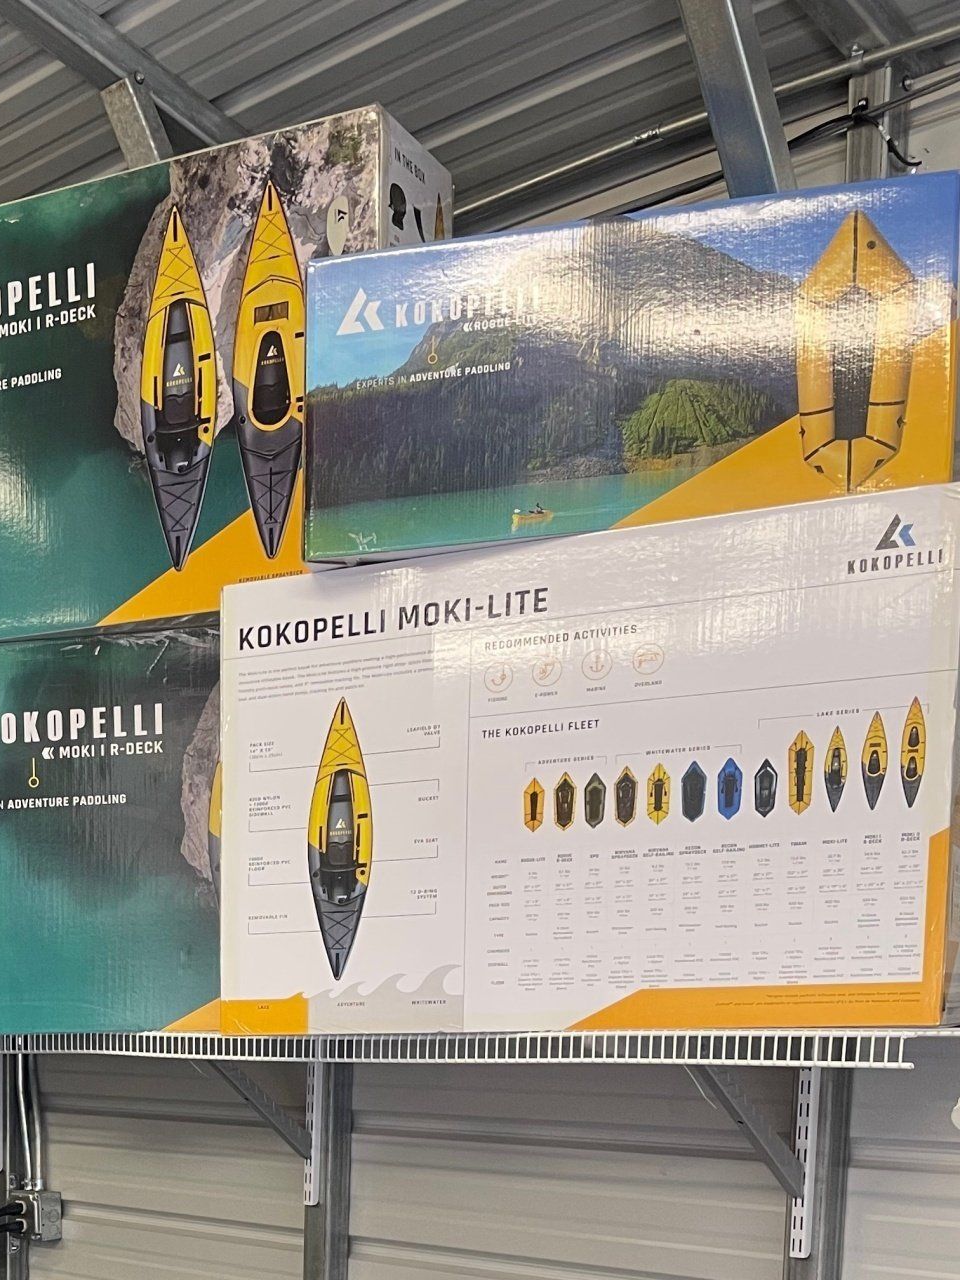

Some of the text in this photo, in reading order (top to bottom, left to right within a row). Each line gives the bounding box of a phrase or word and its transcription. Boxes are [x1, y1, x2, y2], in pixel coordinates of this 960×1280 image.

[45, 304, 96, 328] R-DECK
[11, 367, 62, 389] PADDLING
[356, 361, 511, 389] EXPERTS IN ADVENTURE PADDLING
[847, 548, 943, 574] KOKOPELLI
[238, 587, 550, 651] KOKOPELLI MOKI-LITE
[484, 625, 638, 651] RECOMMENDED ACTIVITIES
[482, 719, 600, 739] THE KOKOPELLI FLEET
[58, 745, 96, 758] MOKI
[110, 741, 164, 755] R-DECK
[646, 748, 686, 756] WHITEWATER
[7, 796, 70, 810] ADVENTURE
[72, 793, 127, 807] PADDLING
